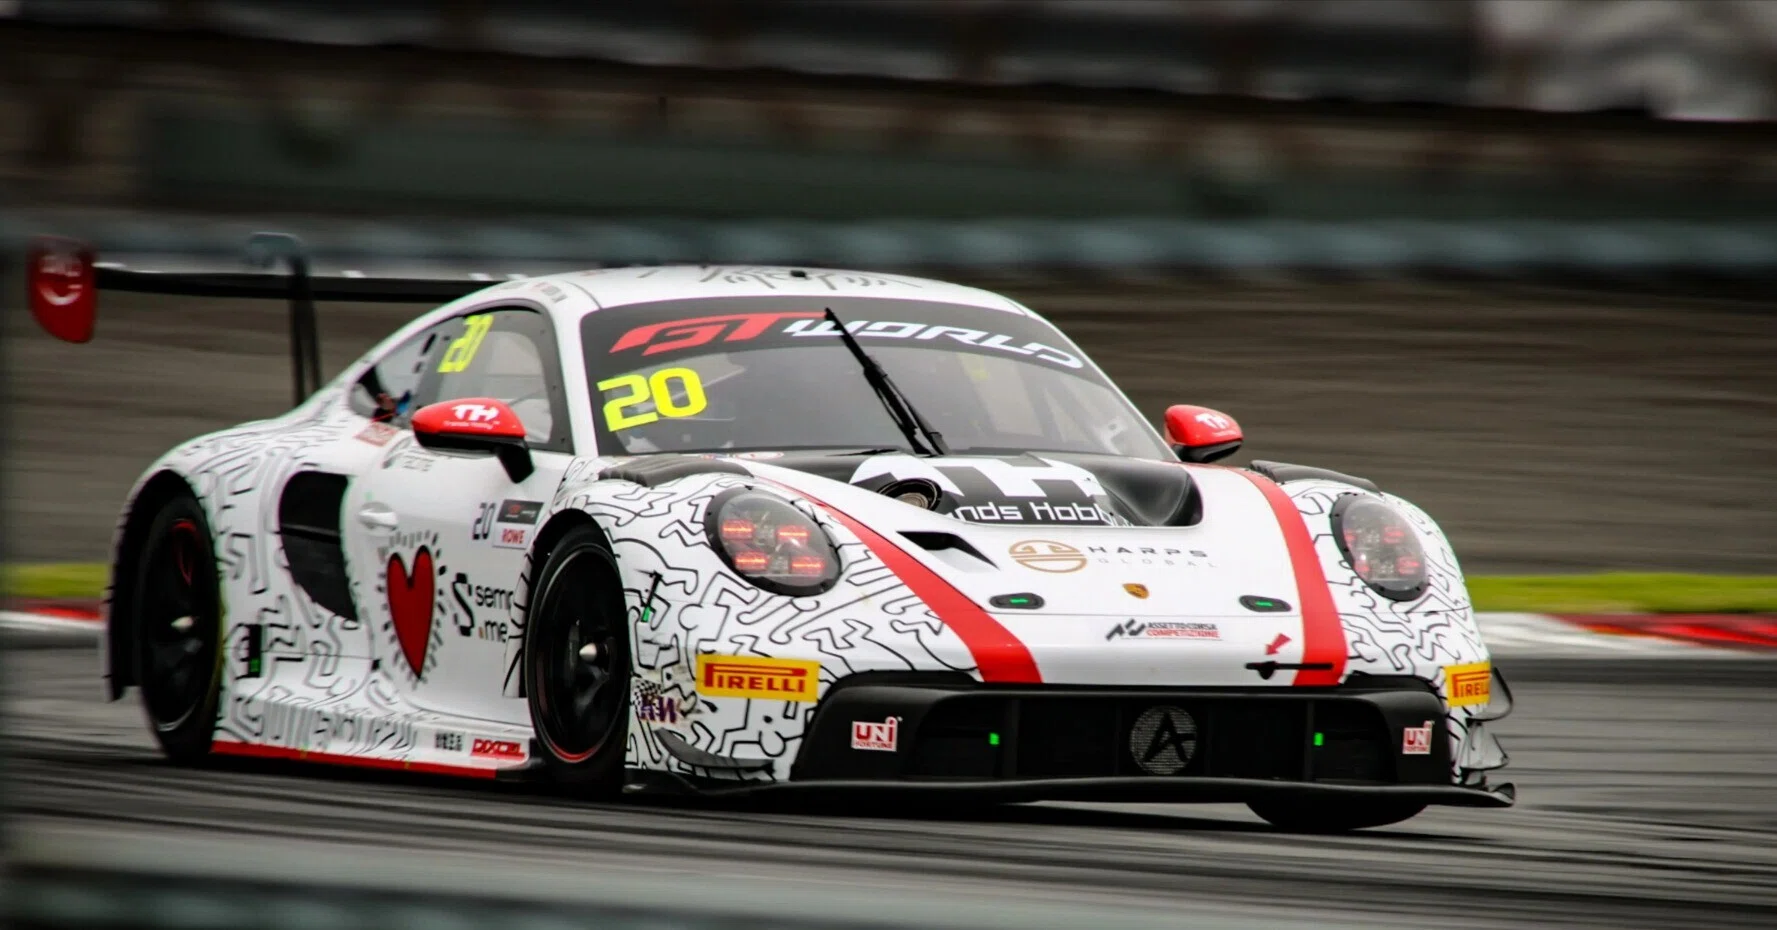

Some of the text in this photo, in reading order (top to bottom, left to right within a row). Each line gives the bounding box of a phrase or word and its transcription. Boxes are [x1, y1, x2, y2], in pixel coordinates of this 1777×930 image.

[609, 311, 1084, 370] GT WORLD
[452, 404, 500, 421] TH
[597, 367, 707, 432] 20
[472, 502, 496, 541] 20
[954, 501, 1023, 522] nds
[1087, 546, 1209, 558] HARPS
[1097, 558, 1218, 569] GLOBAL
[704, 662, 808, 693] PIRELLI
[1451, 669, 1490, 698] PIREL
